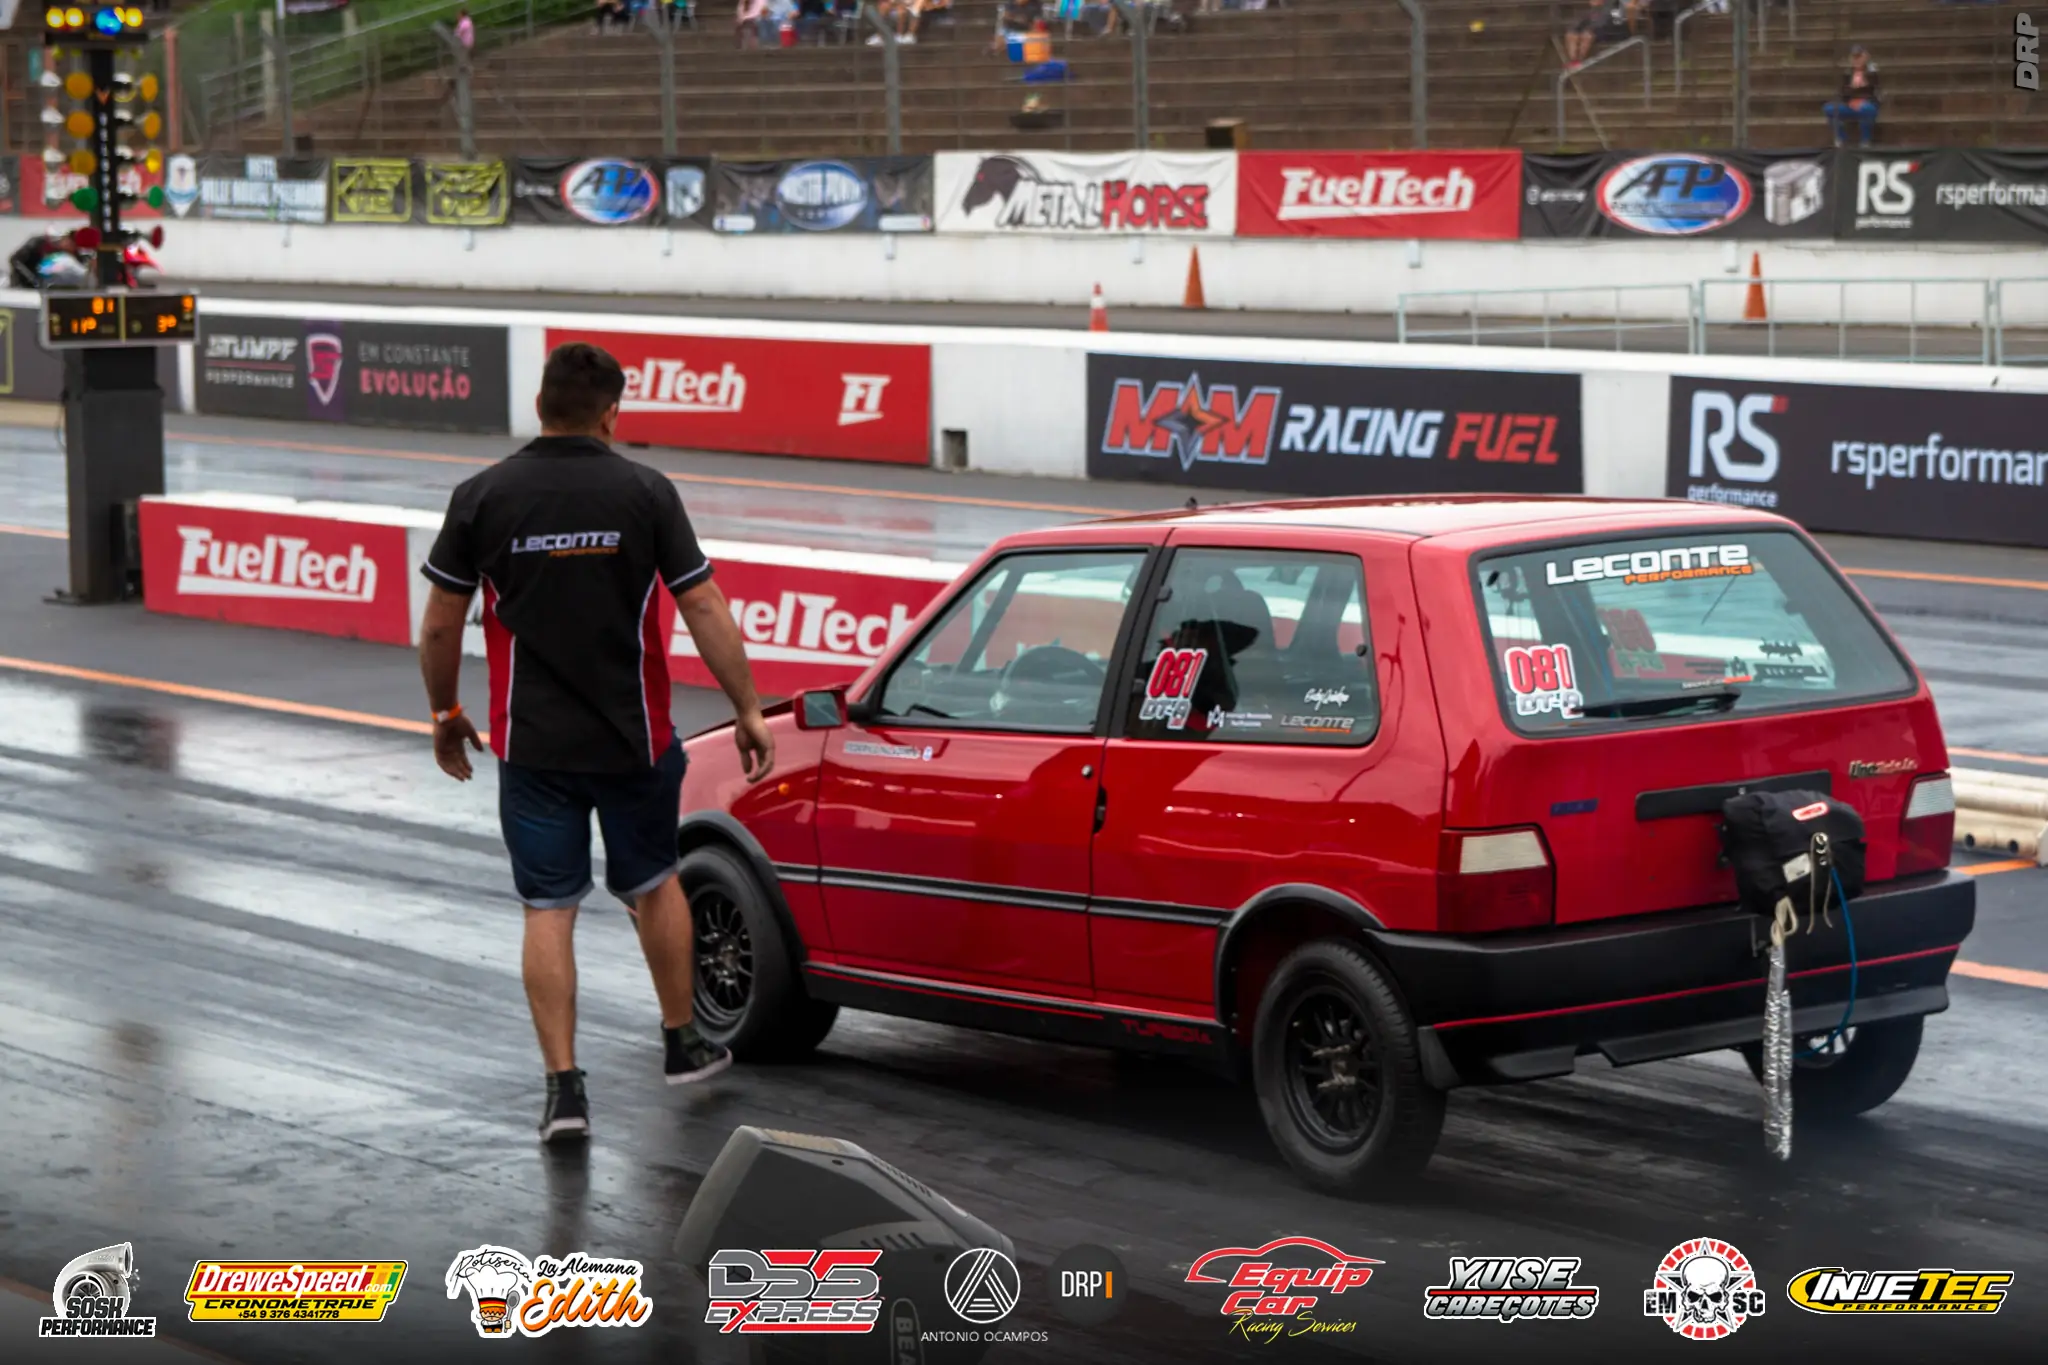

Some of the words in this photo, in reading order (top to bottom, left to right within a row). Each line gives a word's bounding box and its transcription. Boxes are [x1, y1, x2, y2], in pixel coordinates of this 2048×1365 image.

[1277, 167, 1476, 220] FuelTech
[1856, 160, 1920, 215] RS
[360, 366, 471, 400] EVOLUÇÃO
[618, 358, 747, 412] elTech
[1281, 404, 1445, 459] RACING
[1447, 411, 1561, 465] FUEL
[1689, 390, 1789, 483] RS
[177, 525, 378, 603] FuelTech
[1624, 564, 1753, 585] PERFORMANCE
[1147, 649, 1206, 698] 081
[1506, 645, 1575, 694] 081
